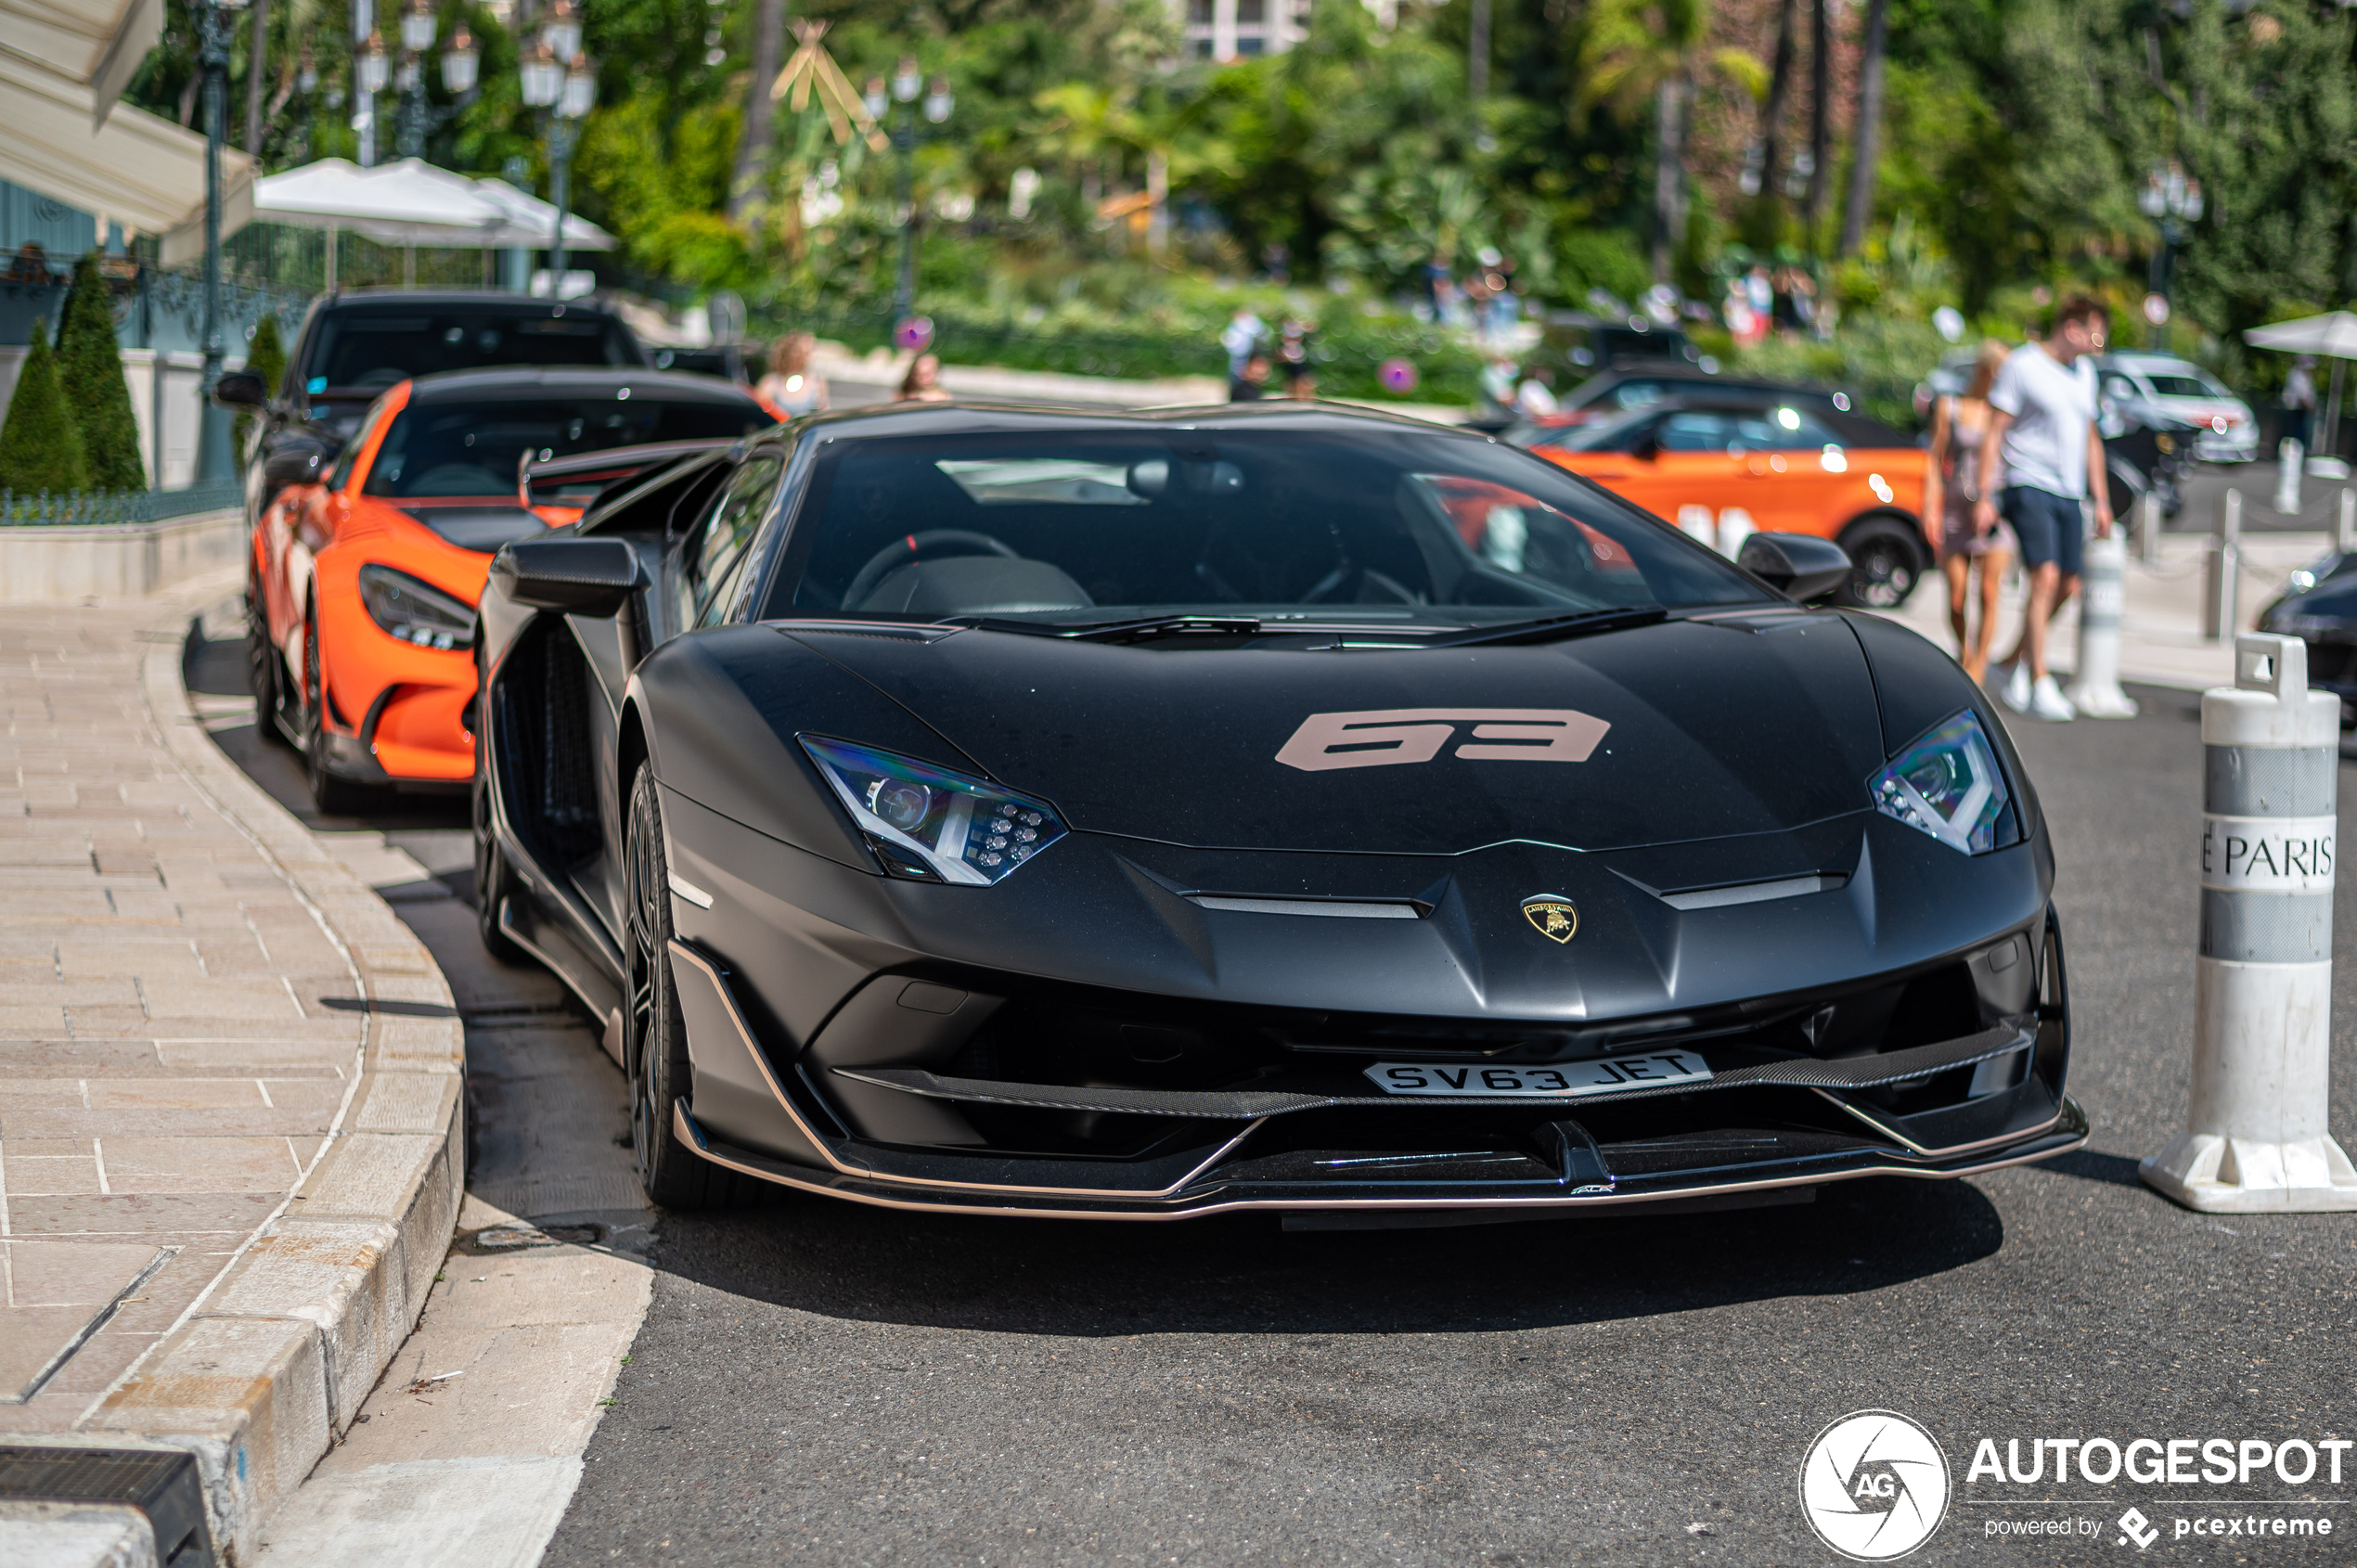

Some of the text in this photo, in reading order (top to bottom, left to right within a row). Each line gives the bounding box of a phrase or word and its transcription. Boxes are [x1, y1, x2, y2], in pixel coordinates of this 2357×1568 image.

[1275, 708, 1611, 771] 63
[2225, 836, 2332, 876] PARIS
[1386, 1055, 1694, 1090] SV63 JET
